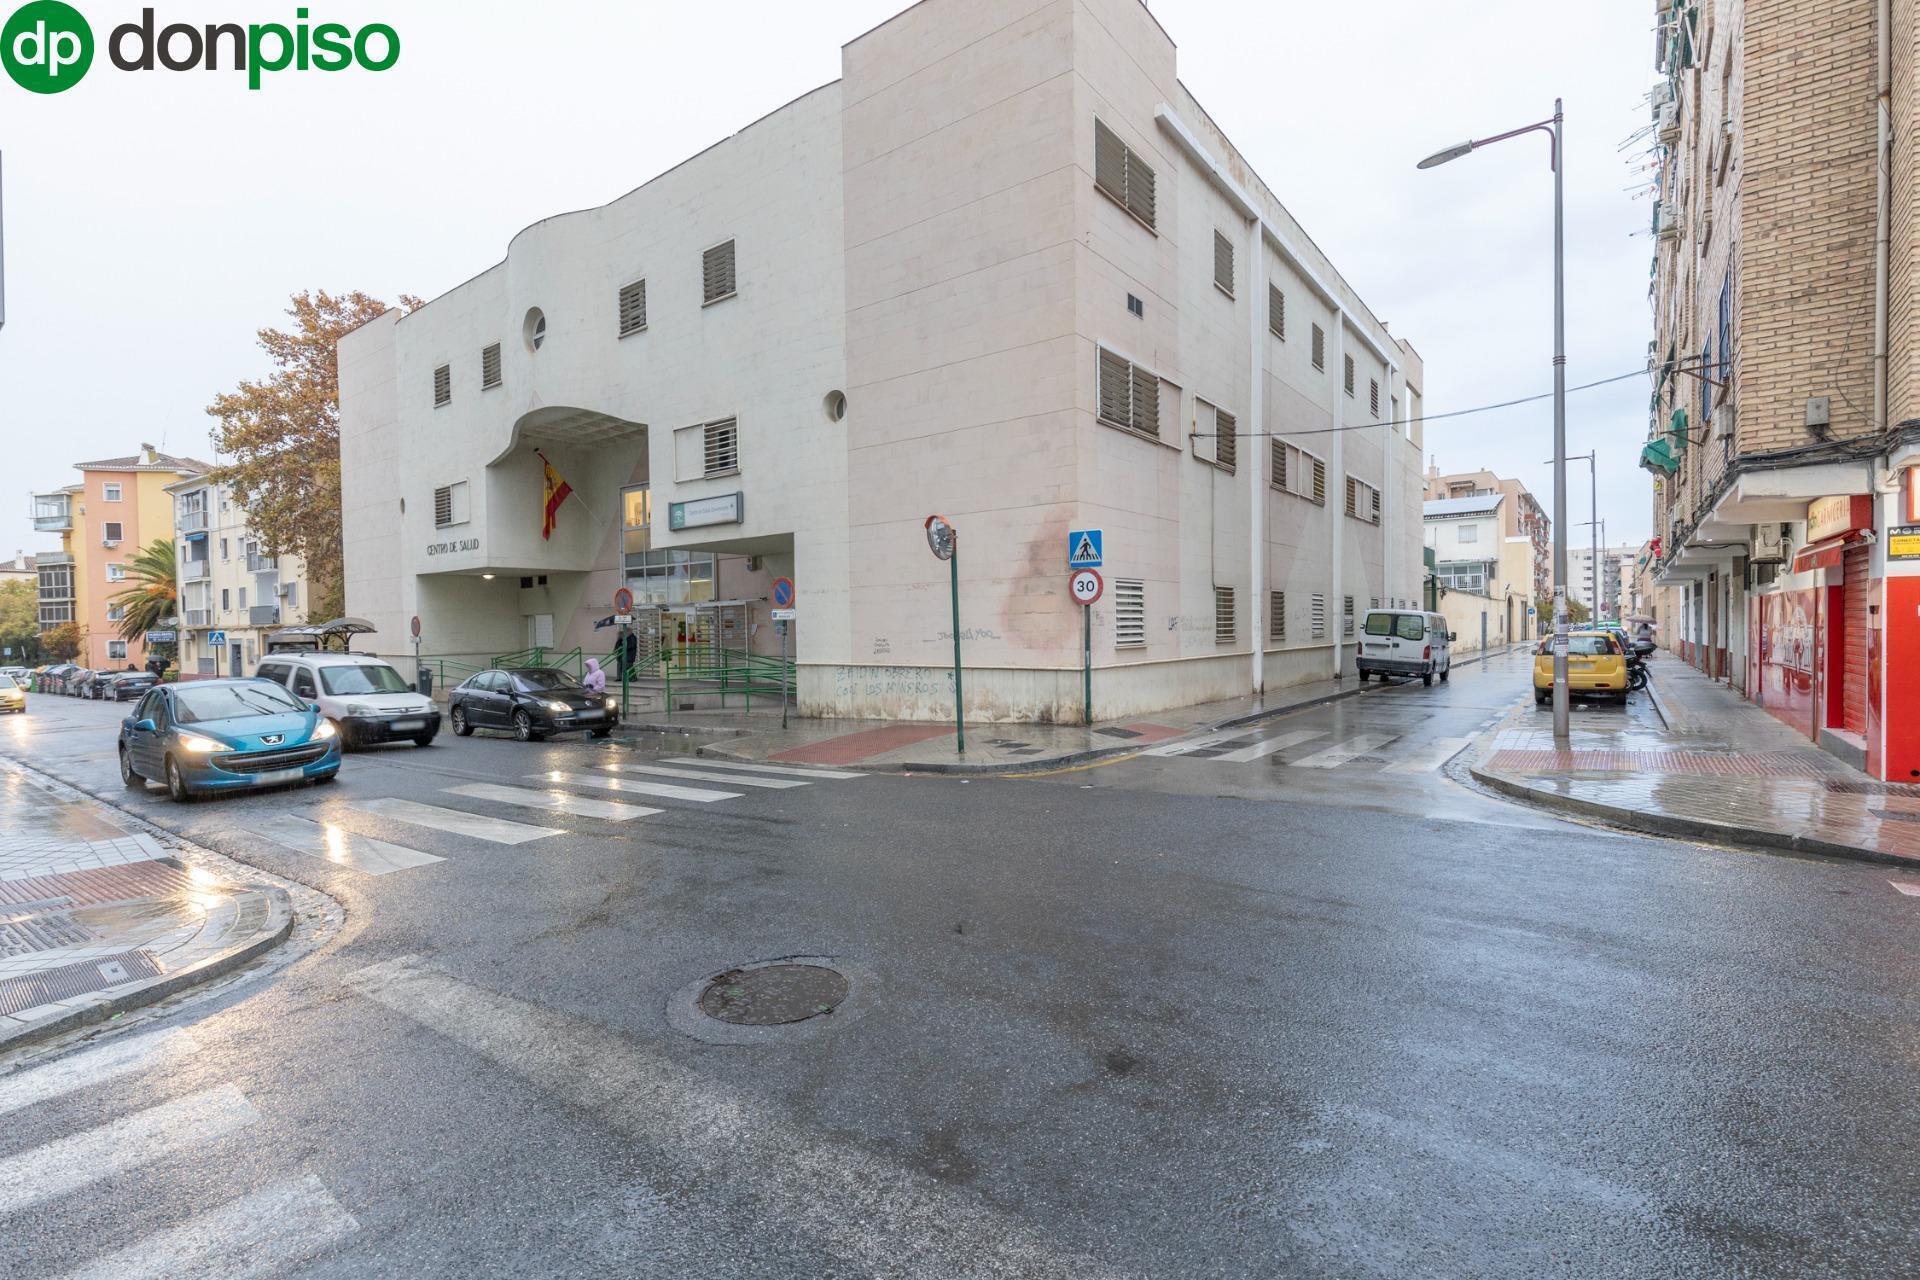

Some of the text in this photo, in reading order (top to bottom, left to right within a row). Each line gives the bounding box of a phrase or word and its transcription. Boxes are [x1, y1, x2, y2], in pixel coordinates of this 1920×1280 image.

[427, 538, 479, 556] CENTRO DE SALUD
[1077, 580, 1095, 592] 30
